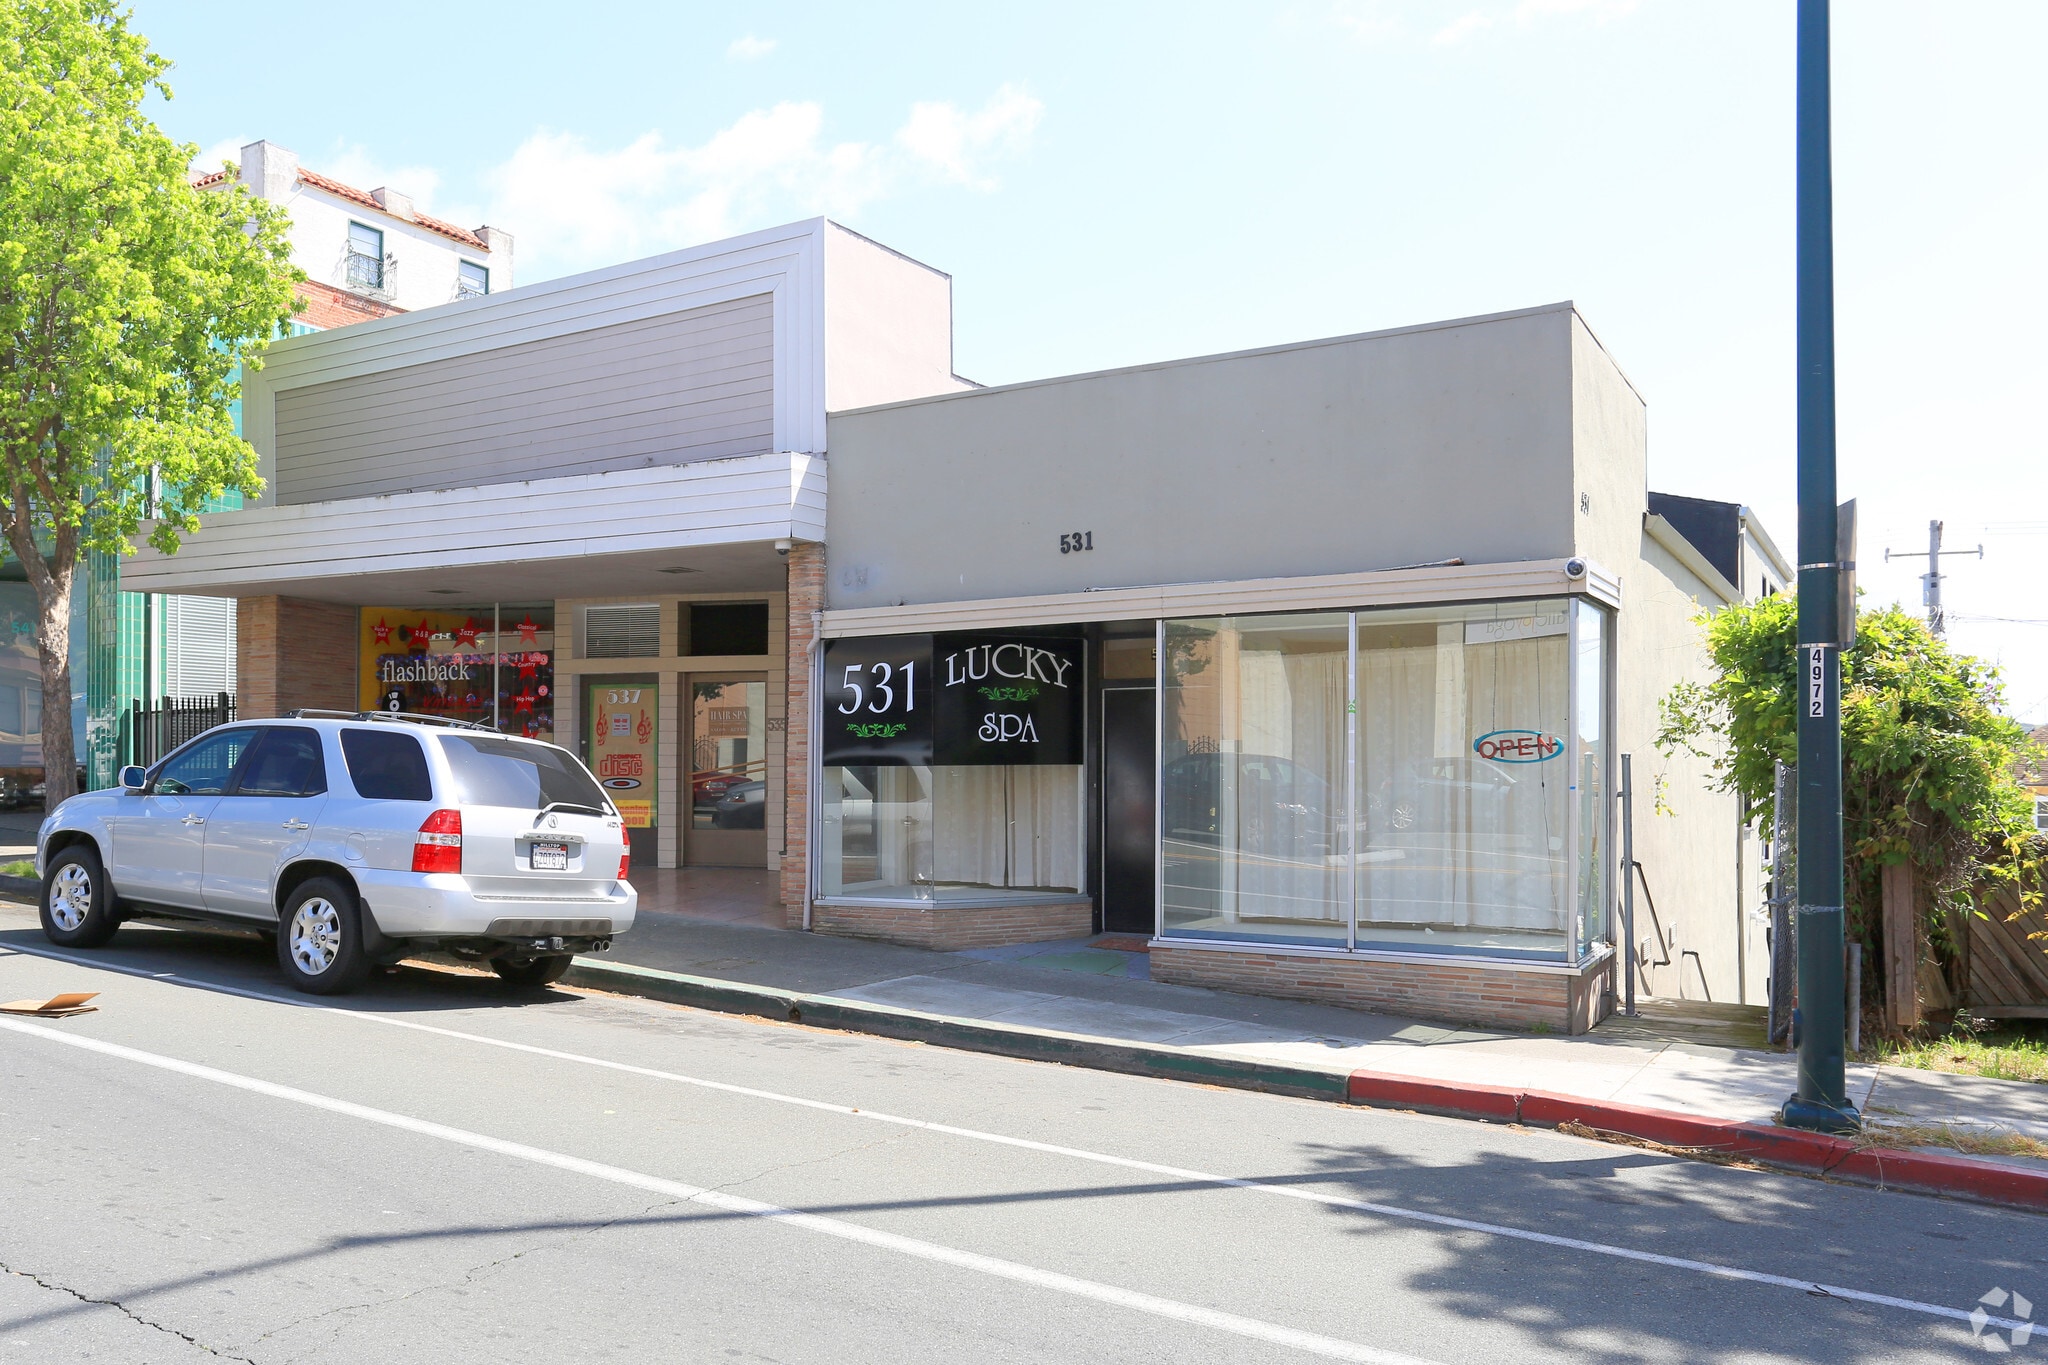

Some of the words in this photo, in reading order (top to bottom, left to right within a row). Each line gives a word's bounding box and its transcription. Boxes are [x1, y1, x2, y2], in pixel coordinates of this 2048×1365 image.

[1060, 531, 1094, 553] 531
[383, 659, 470, 682] flashback
[945, 643, 1073, 689] LUCKY
[837, 660, 915, 715] 531
[1812, 649, 1822, 715] 4972
[607, 690, 641, 704] 537
[710, 711, 731, 720] HAIR
[732, 710, 747, 720] SPA
[978, 713, 1040, 743] SPA
[1478, 736, 1554, 759] OPEN
[600, 754, 642, 776] disc
[625, 816, 645, 825] oon
